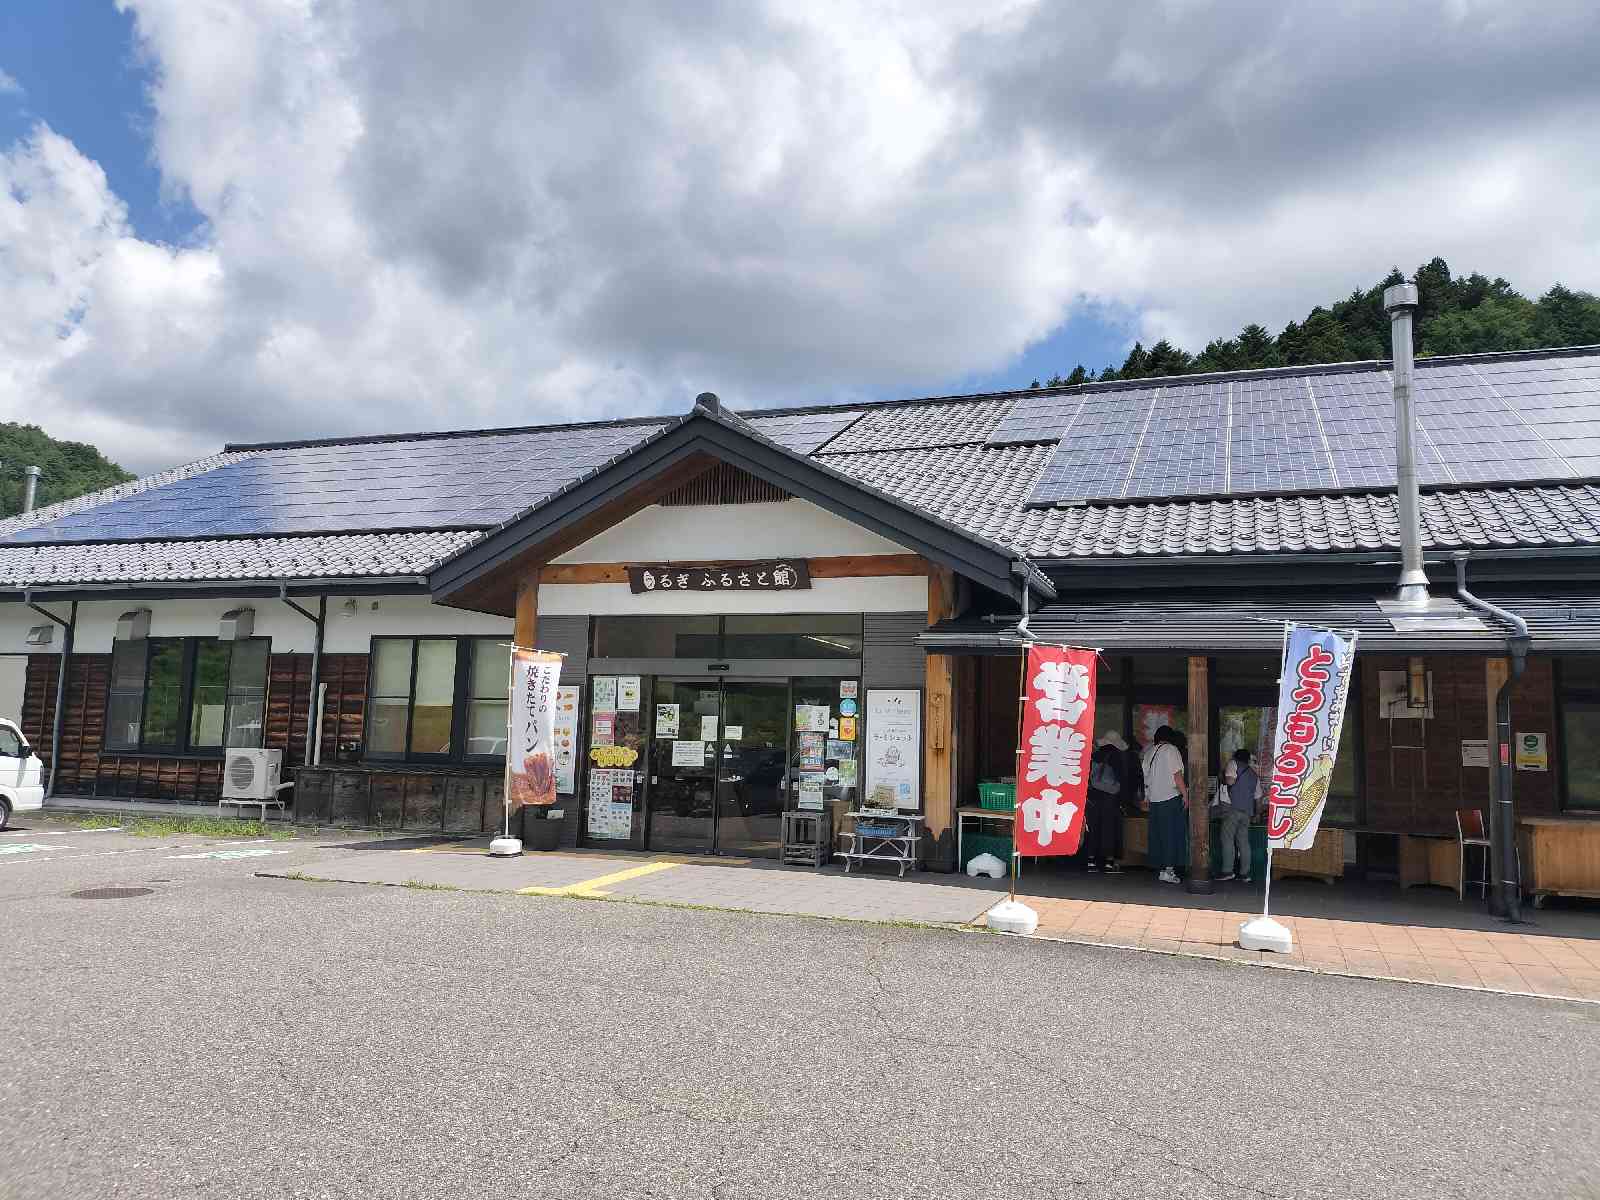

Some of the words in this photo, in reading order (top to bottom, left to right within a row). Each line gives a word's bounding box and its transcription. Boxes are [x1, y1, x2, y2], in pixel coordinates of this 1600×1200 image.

[701, 569, 792, 587] ふるさと館
[525, 665, 540, 753] 焼きたてパン
[539, 666, 552, 713] こだわりの
[1023, 661, 1090, 846] 営業中
[1267, 643, 1335, 840] とうもろこし
